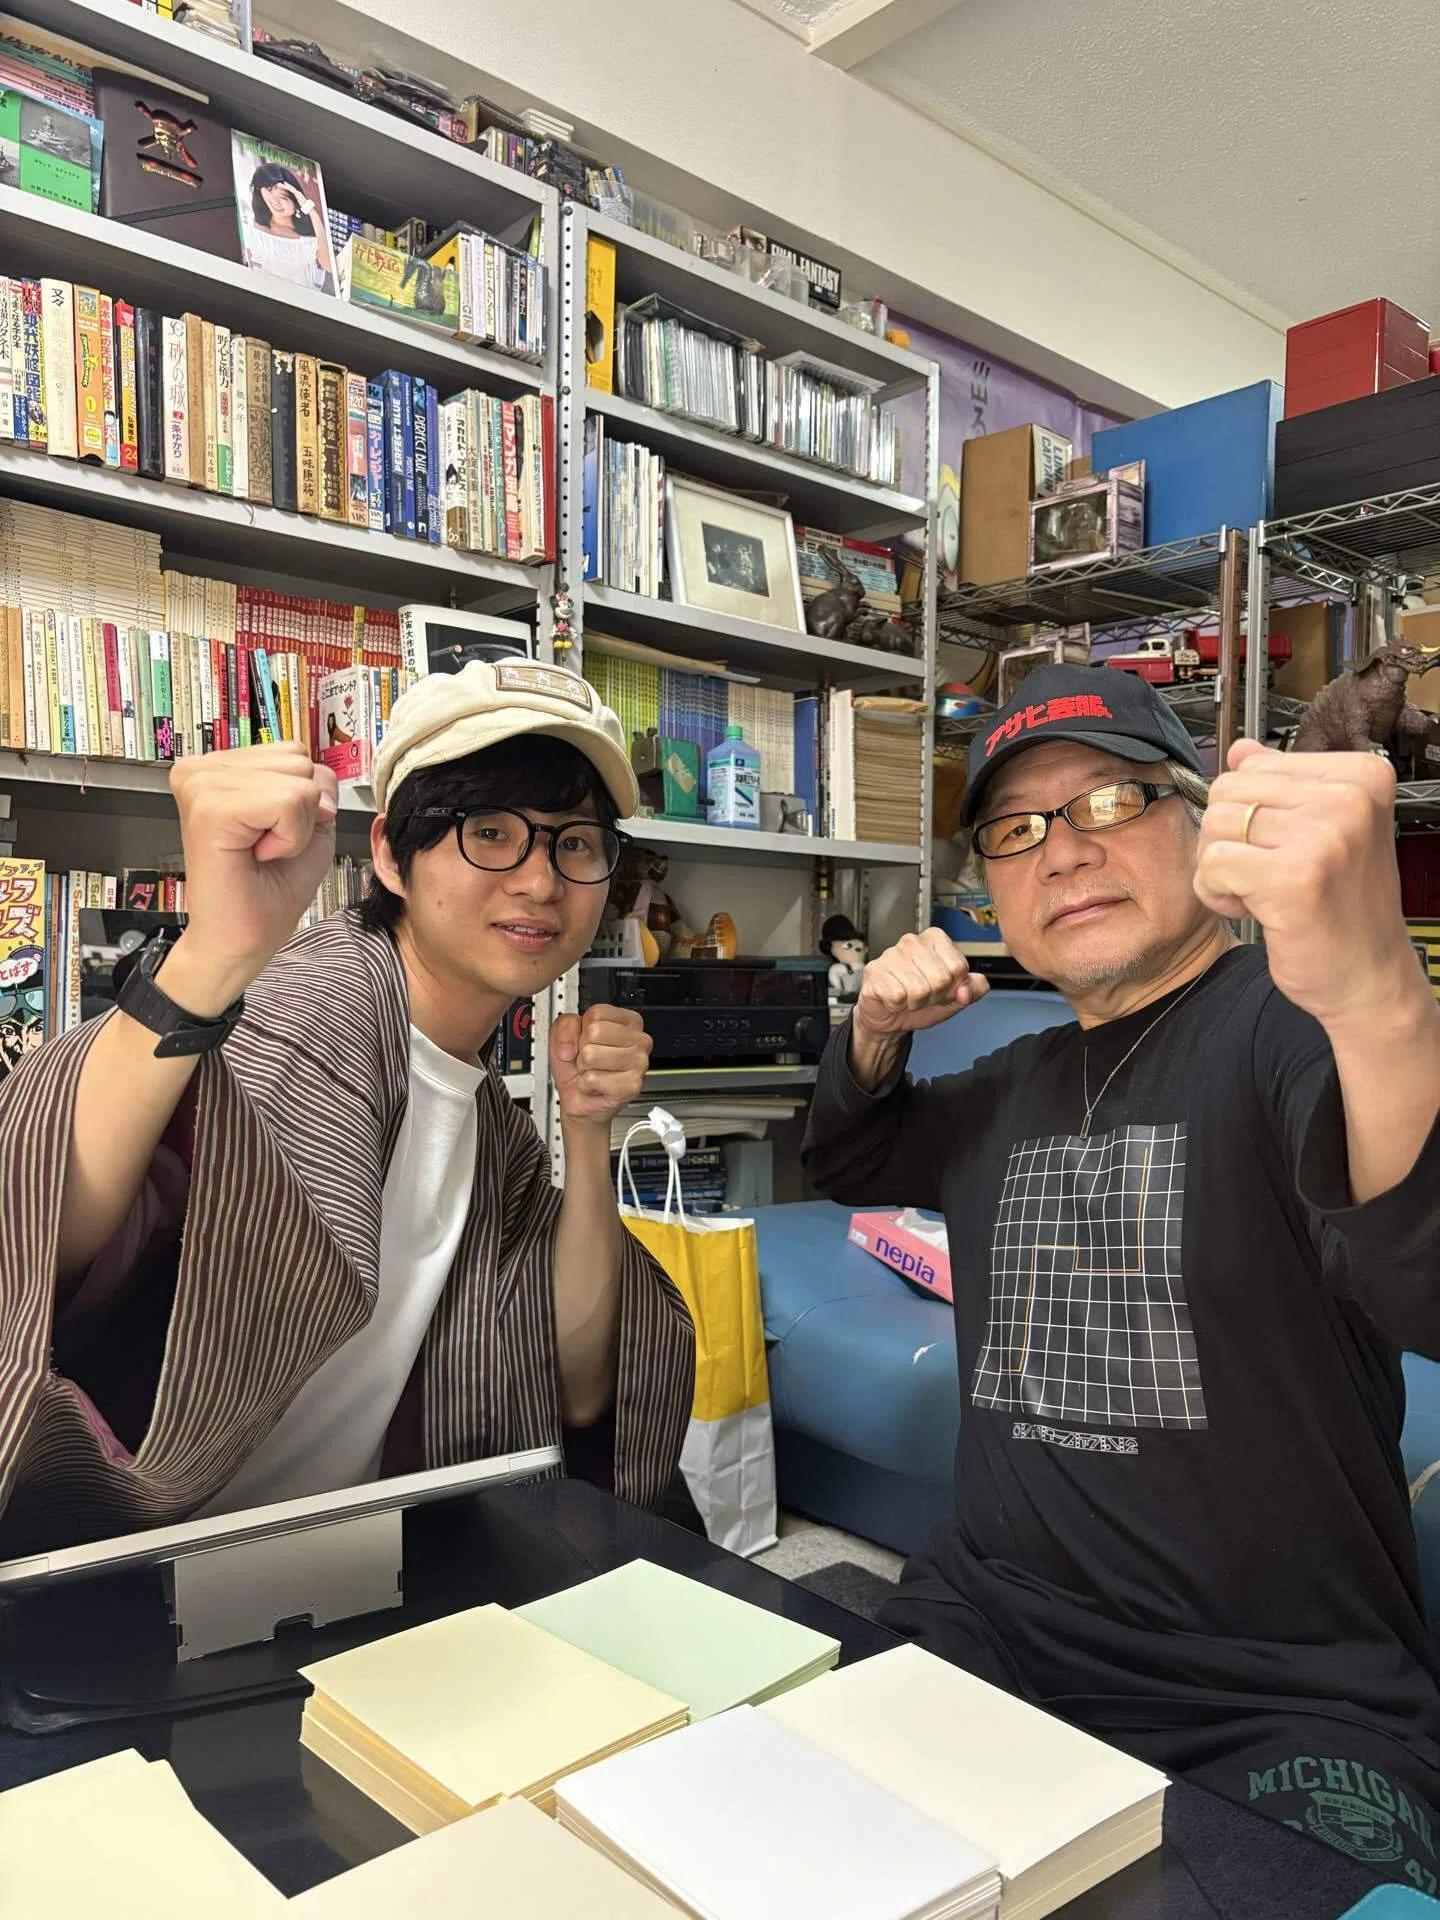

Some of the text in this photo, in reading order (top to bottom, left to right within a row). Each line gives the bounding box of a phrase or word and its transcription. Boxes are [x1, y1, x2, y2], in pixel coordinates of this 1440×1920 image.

[355, 242, 402, 273] ゲド戦記
[800, 256, 840, 294] FANTASY
[167, 340, 187, 411] 砂の城
[393, 398, 402, 473] PERFECT BLUE
[1041, 436, 1053, 495] CAPTAIN
[985, 694, 1113, 757] アサヒ芸能
[71, 936, 80, 956] OF
[70, 958, 81, 1002] KINDS
[876, 1236, 935, 1285] nepia
